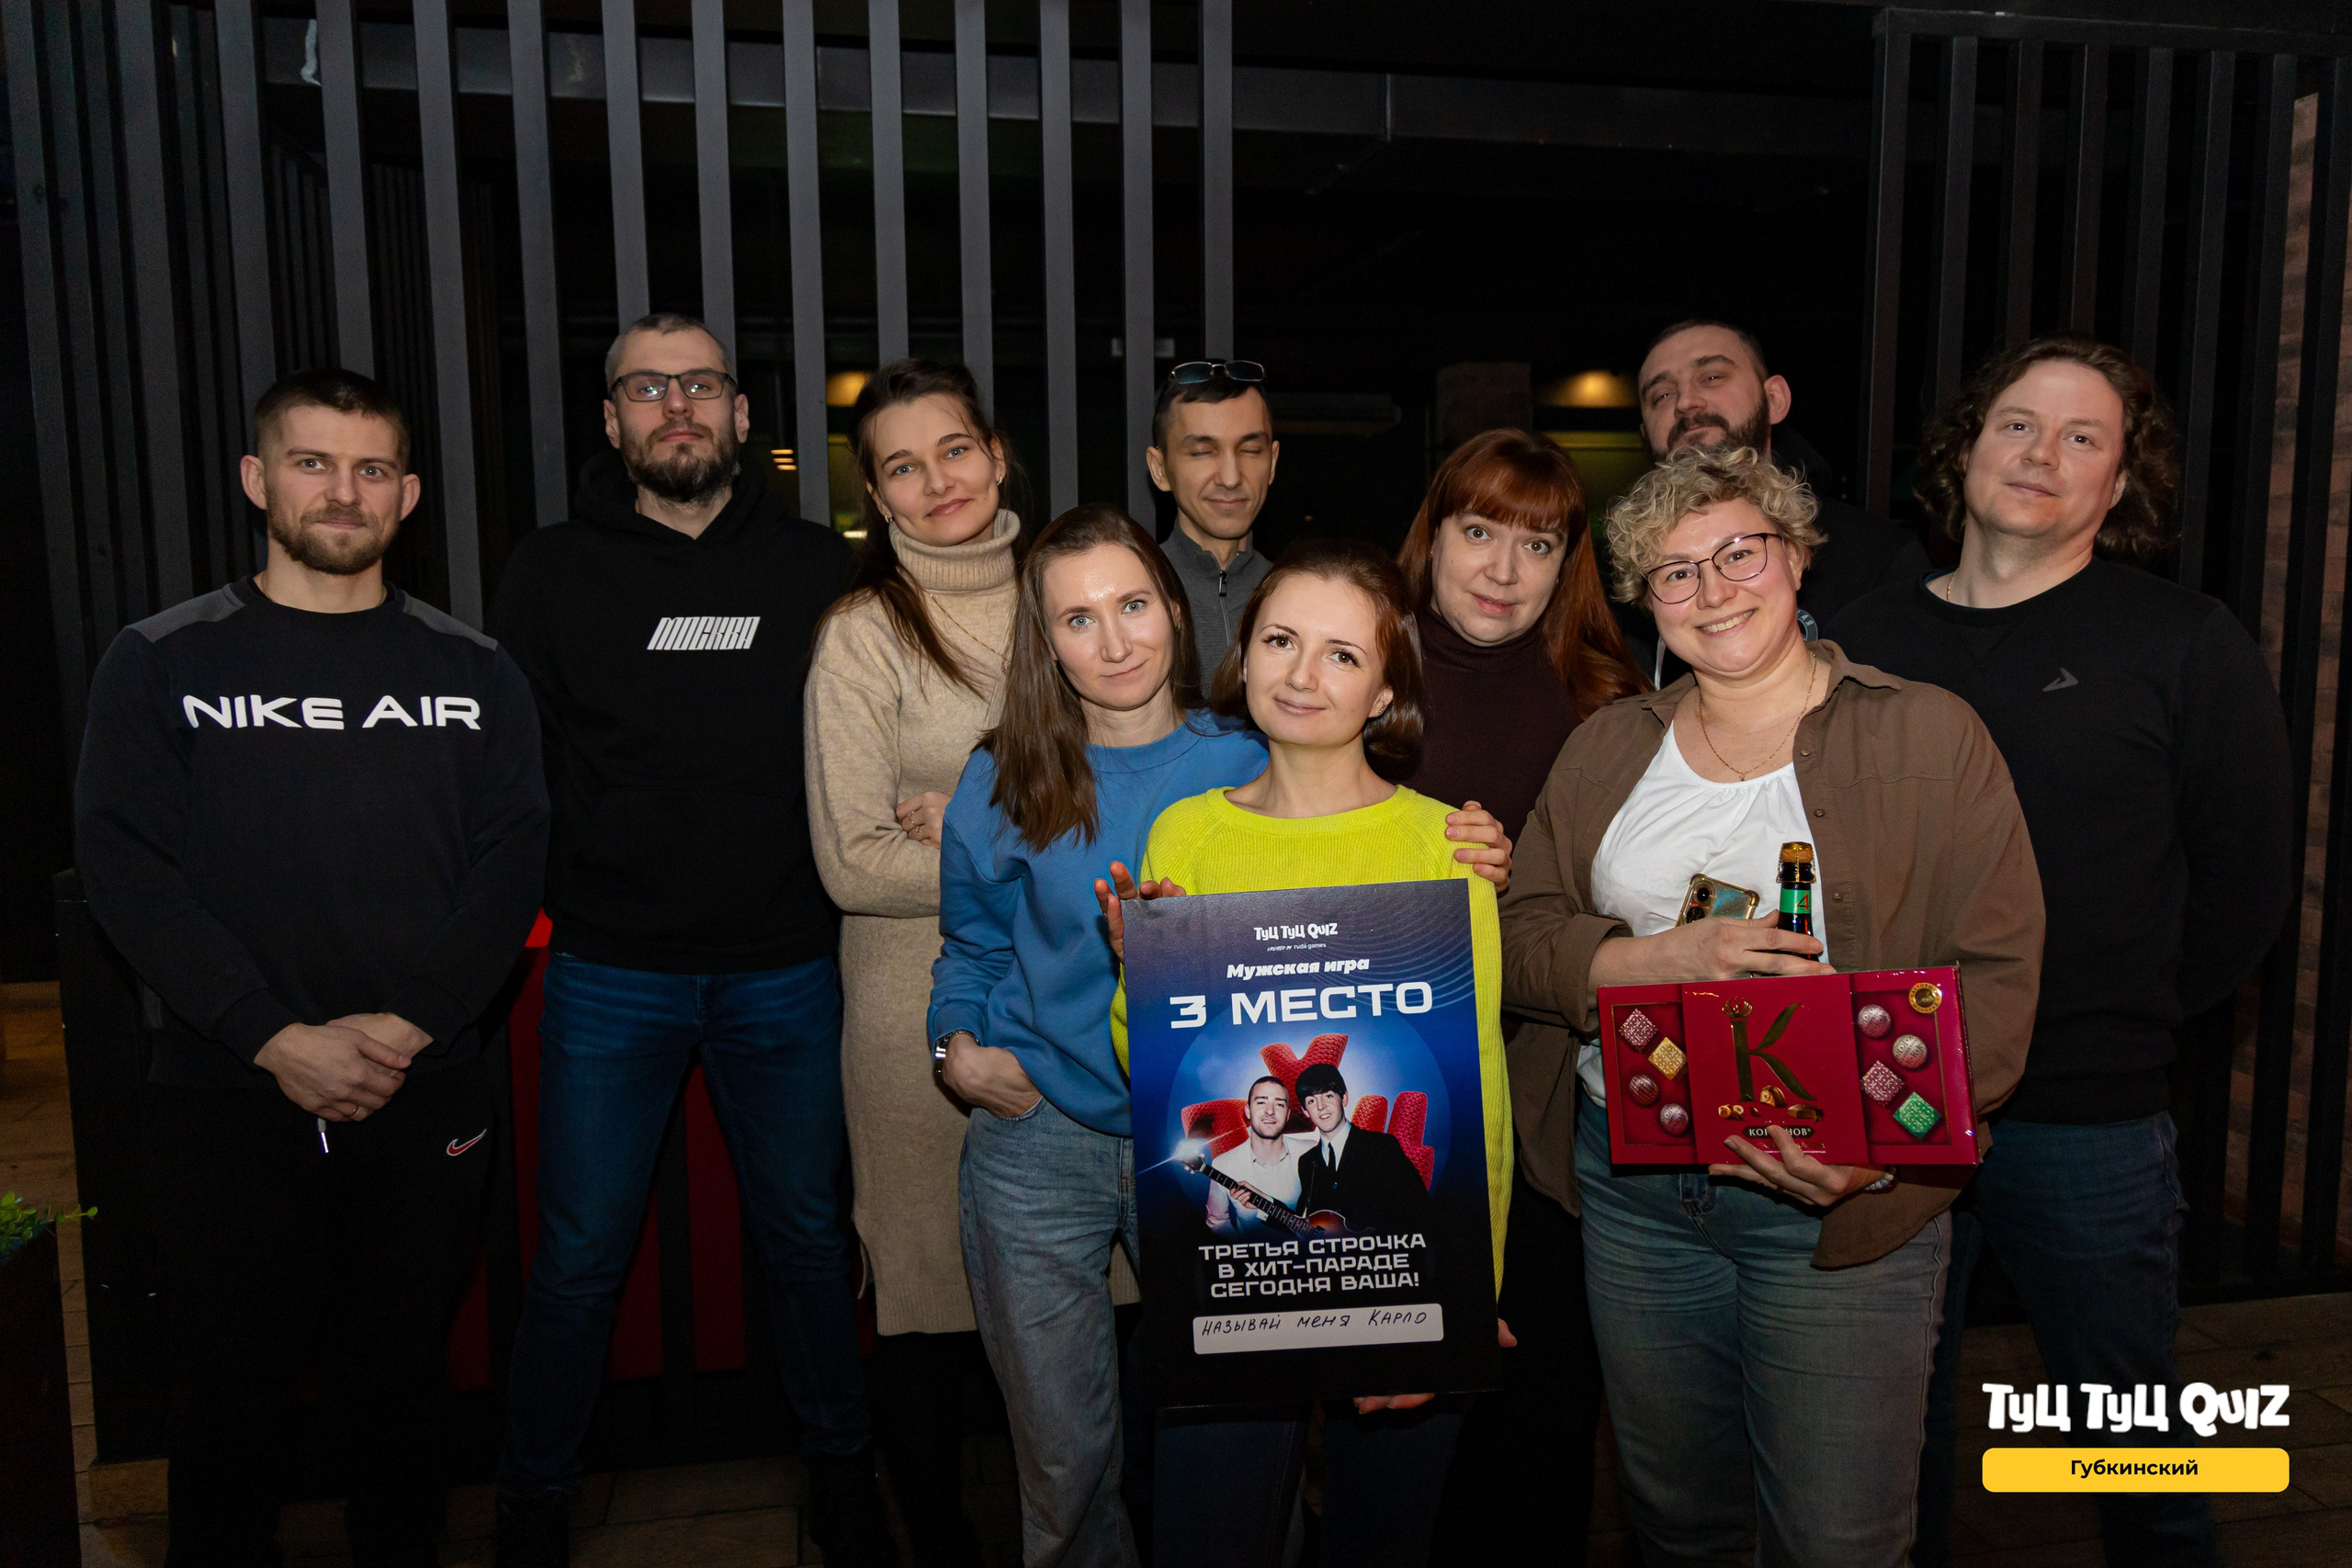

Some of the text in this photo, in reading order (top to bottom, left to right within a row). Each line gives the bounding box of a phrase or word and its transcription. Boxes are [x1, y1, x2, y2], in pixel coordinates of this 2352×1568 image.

[647, 616, 761, 650] МОСКВА
[182, 694, 481, 730] NIKE AIR
[1227, 958, 1370, 981] Мужская игра
[1170, 981, 1433, 1029] 3 МЕСТО
[1198, 1233, 1427, 1261] ТРЕТЬЯ СТРОЧКА
[1218, 1253, 1410, 1279] В ХИТ-ПАРАДЕ
[1210, 1271, 1419, 1299] СЕГОДНЯ ВАША!
